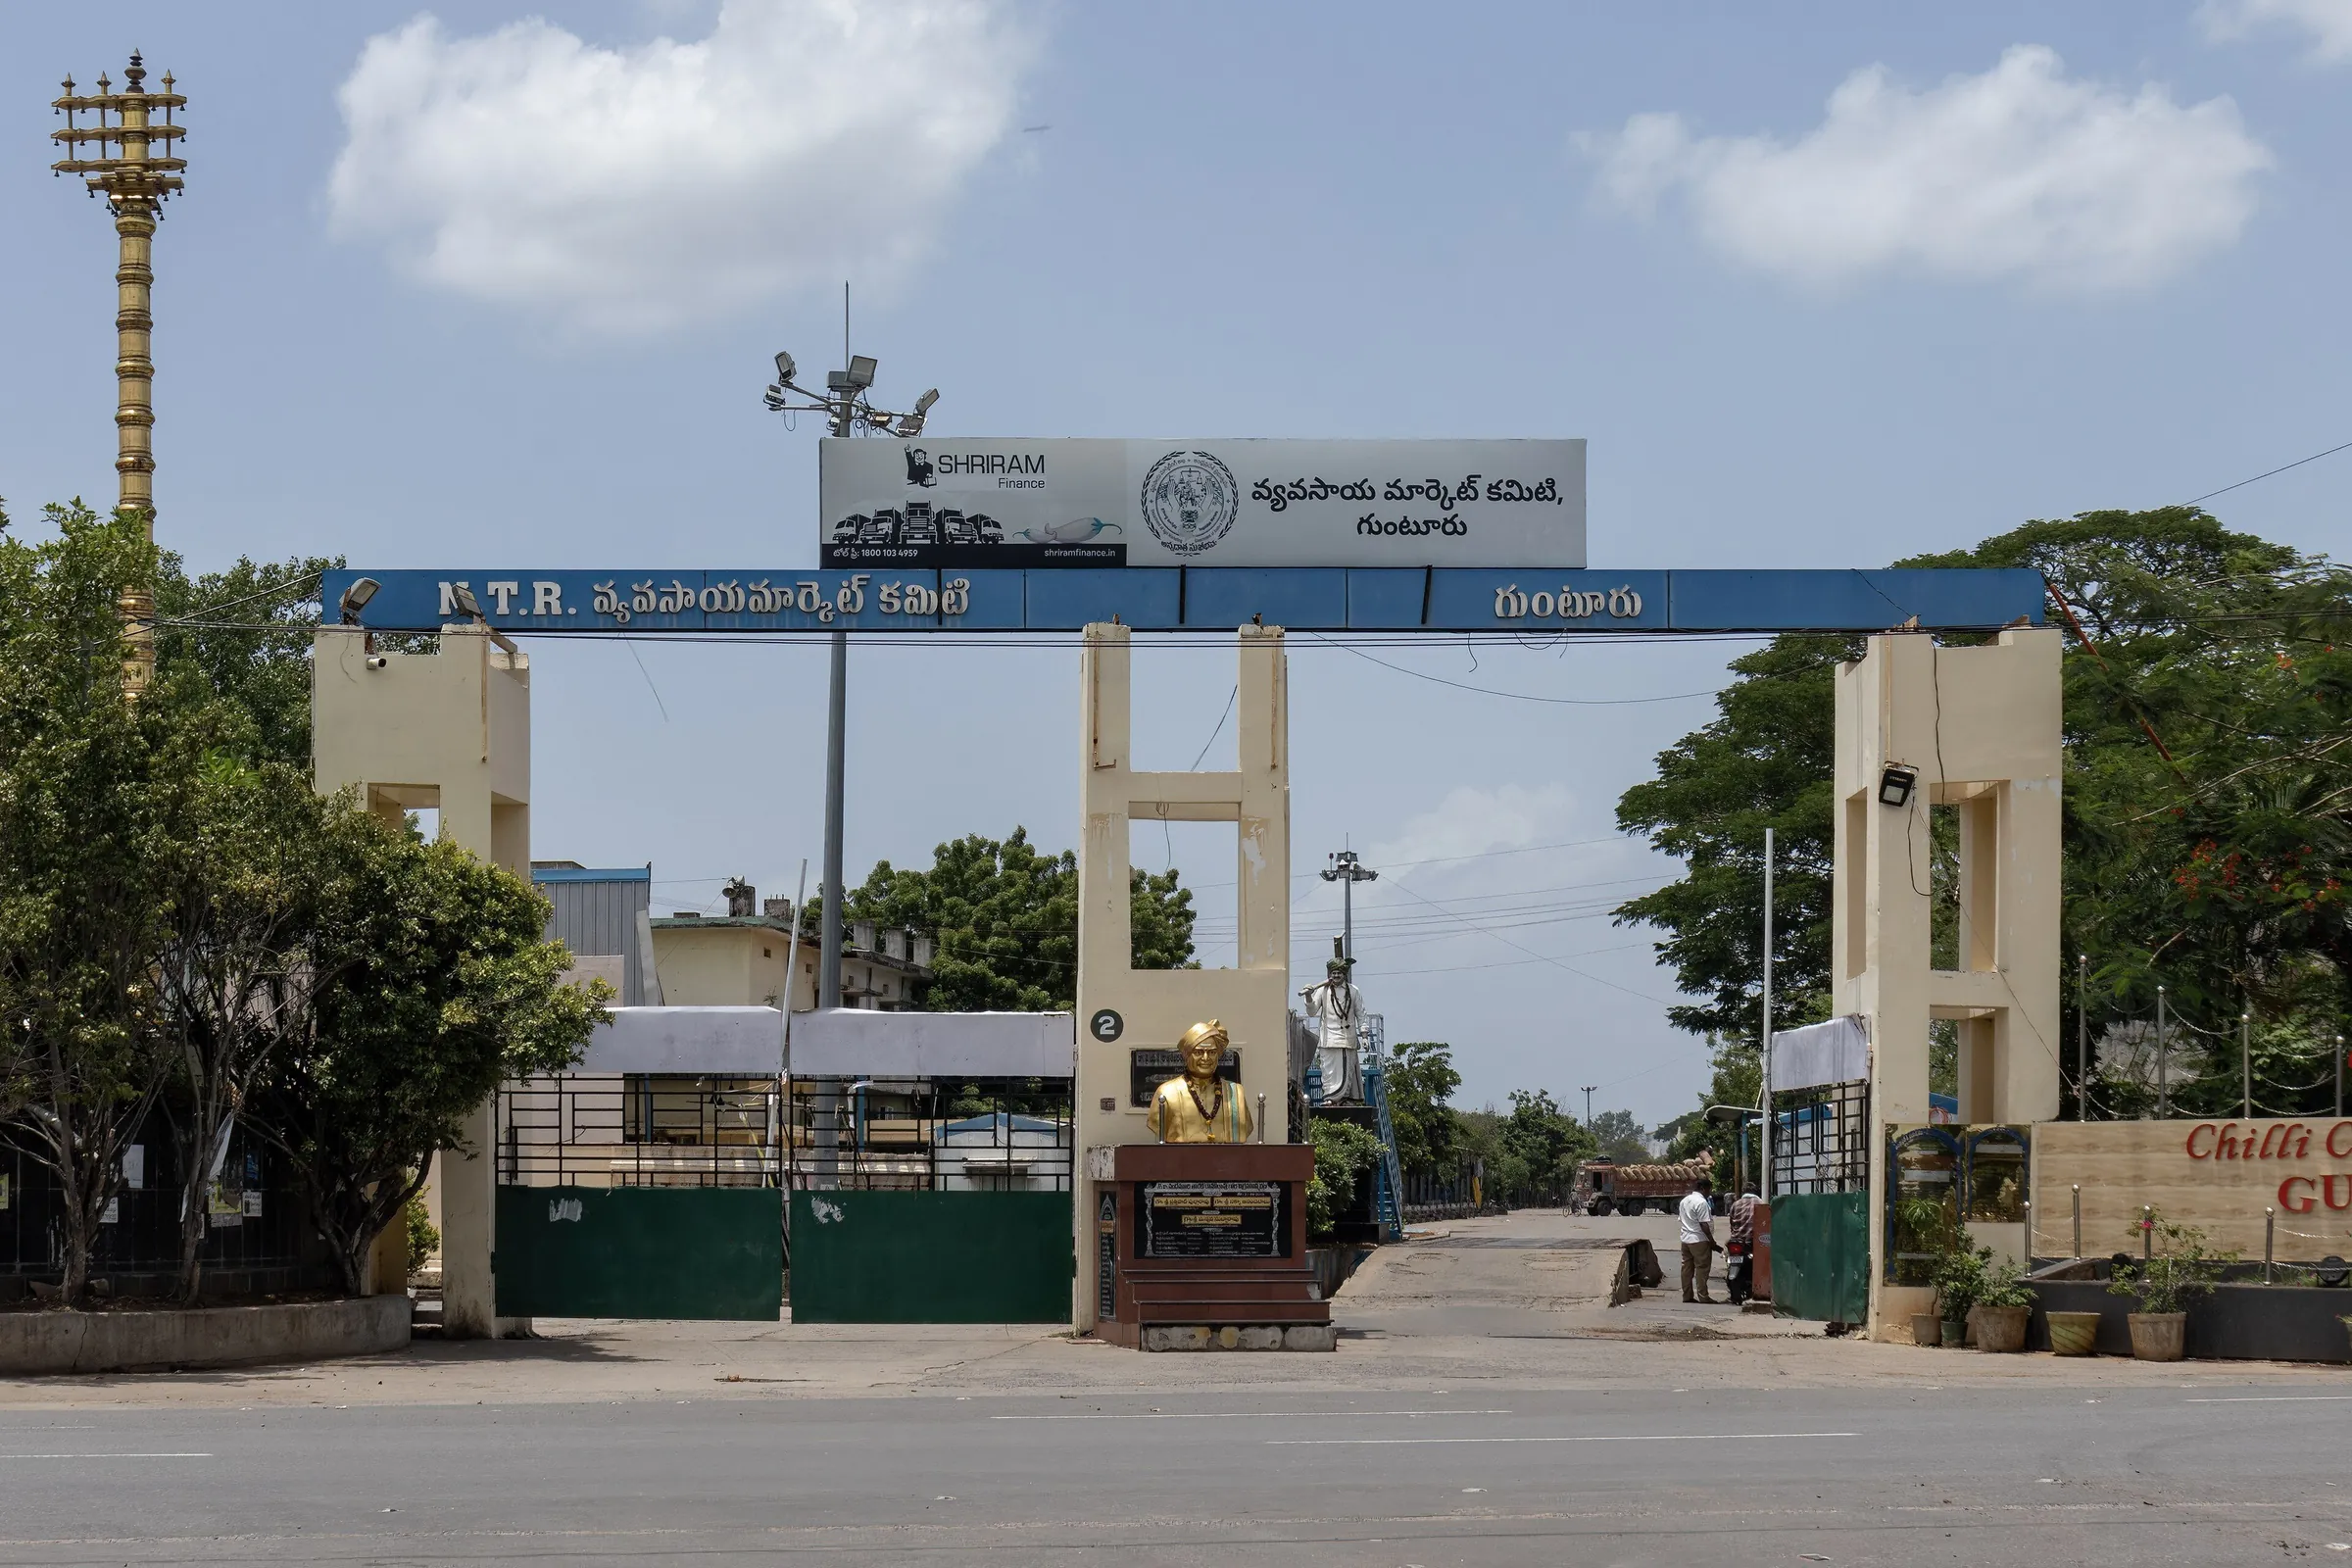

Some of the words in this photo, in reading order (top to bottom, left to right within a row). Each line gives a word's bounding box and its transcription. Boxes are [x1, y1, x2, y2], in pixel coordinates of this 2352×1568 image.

[938, 454, 1045, 474] SHRIRAM
[998, 477, 1046, 489] Finance
[1250, 477, 1376, 513] వ్యవసాయ
[1383, 474, 1482, 512] మార్కెట్
[1356, 514, 1468, 537] గుంటూరు
[861, 549, 882, 558] 1800
[883, 549, 897, 558] 103
[898, 549, 918, 558] 4959
[1044, 548, 1116, 557] shriramfinance.in
[1494, 583, 1643, 618] గుంటూరు
[1098, 1015, 1116, 1035] 2
[2186, 1122, 2313, 1160] Chilli
[2278, 1172, 2352, 1214] GU
